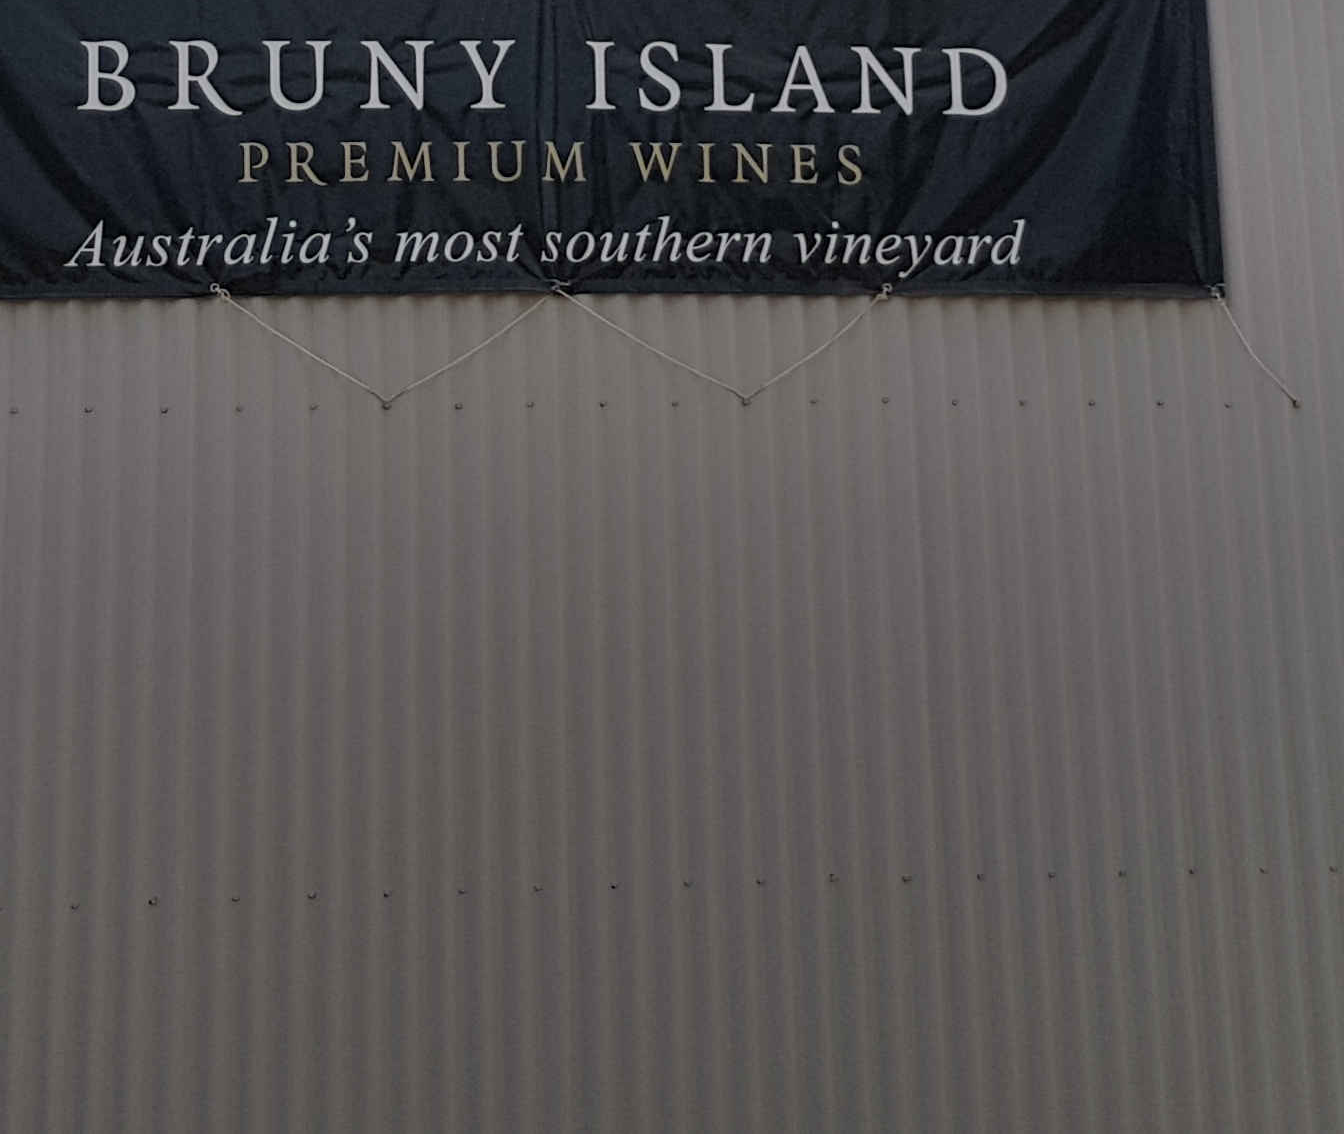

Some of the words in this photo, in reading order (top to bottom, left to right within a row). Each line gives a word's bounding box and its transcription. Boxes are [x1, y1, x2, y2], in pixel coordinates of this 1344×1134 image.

[75, 39, 517, 118] BRUNY
[584, 39, 1009, 118] ISLAND
[237, 140, 588, 187] PREMIUM
[627, 140, 863, 187] WINES
[63, 216, 374, 268] Australia's
[393, 222, 526, 264] most
[539, 215, 774, 265] southern
[791, 218, 1028, 280] vineyard
